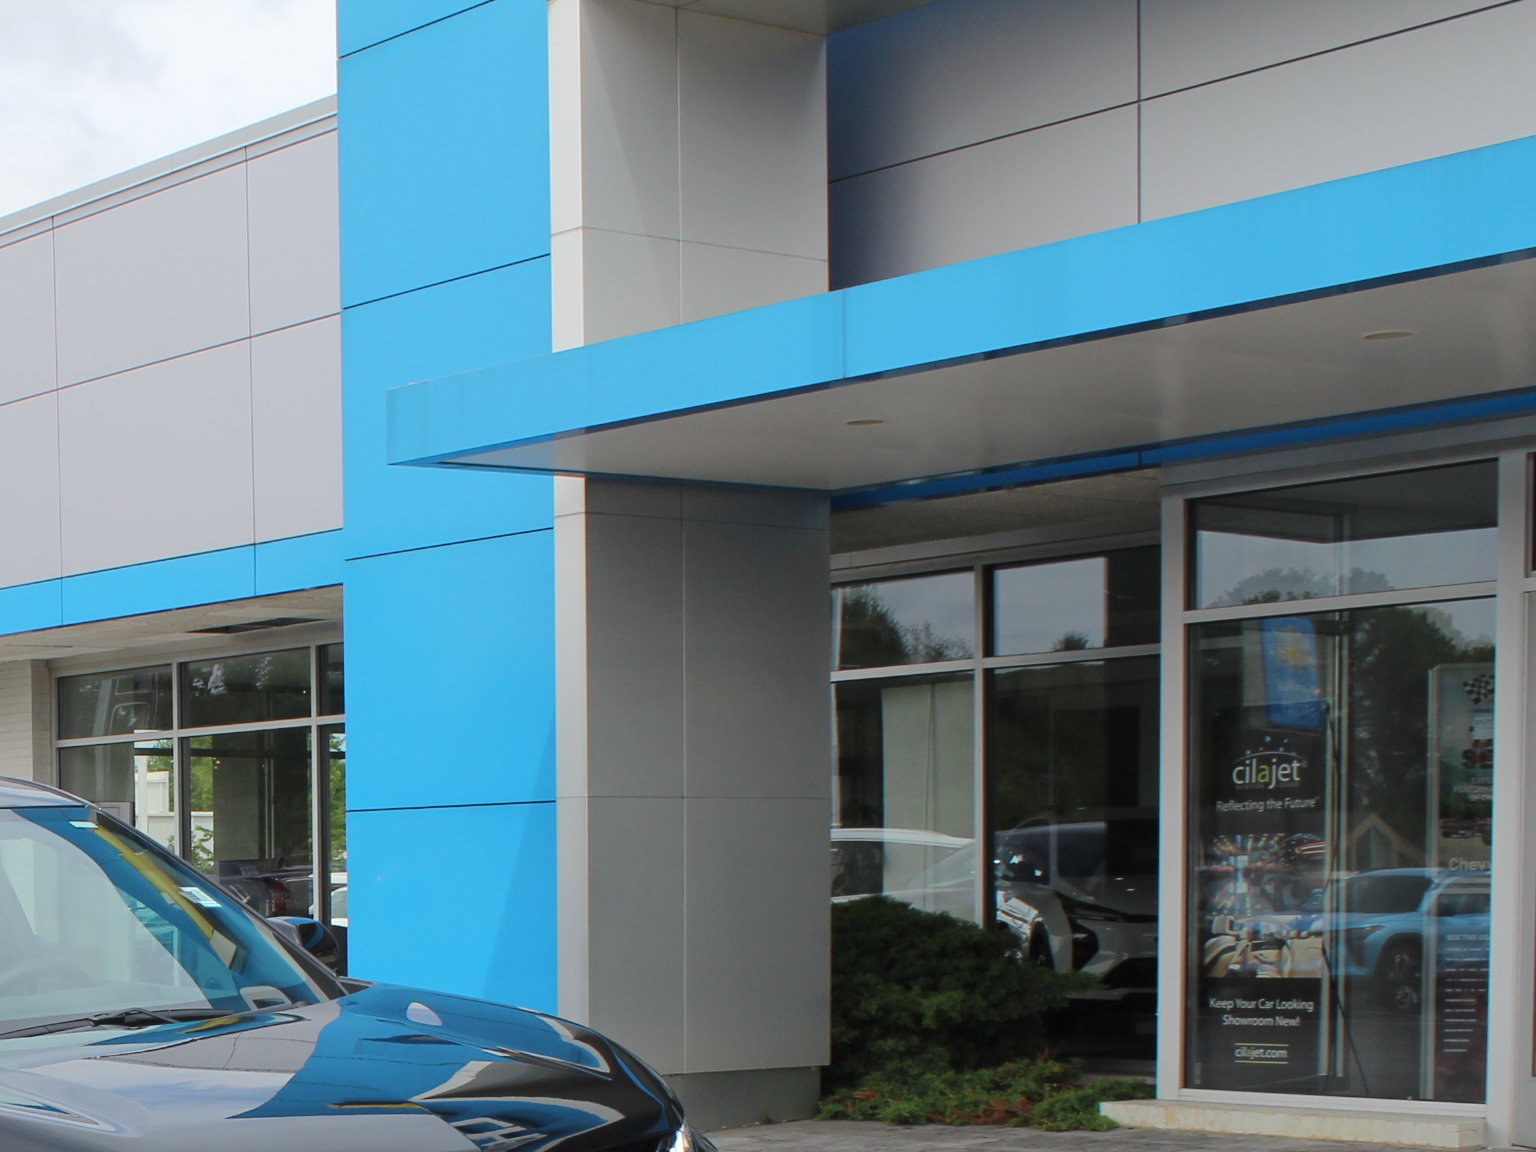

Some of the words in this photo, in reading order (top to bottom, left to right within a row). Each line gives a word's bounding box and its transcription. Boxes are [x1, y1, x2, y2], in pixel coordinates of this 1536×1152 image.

[1232, 758, 1301, 789] cilajet
[1216, 800, 1264, 812] Reflecting
[1266, 799, 1282, 809] the
[1284, 797, 1316, 809] Future
[1209, 998, 1233, 1010] Keep
[1235, 998, 1256, 1009] Your
[1258, 998, 1274, 1009] Car
[1276, 999, 1314, 1012] Looking
[1222, 1014, 1273, 1026] Showroom
[1275, 1016, 1300, 1027] New!
[1234, 1046, 1288, 1060] cilajet.com
